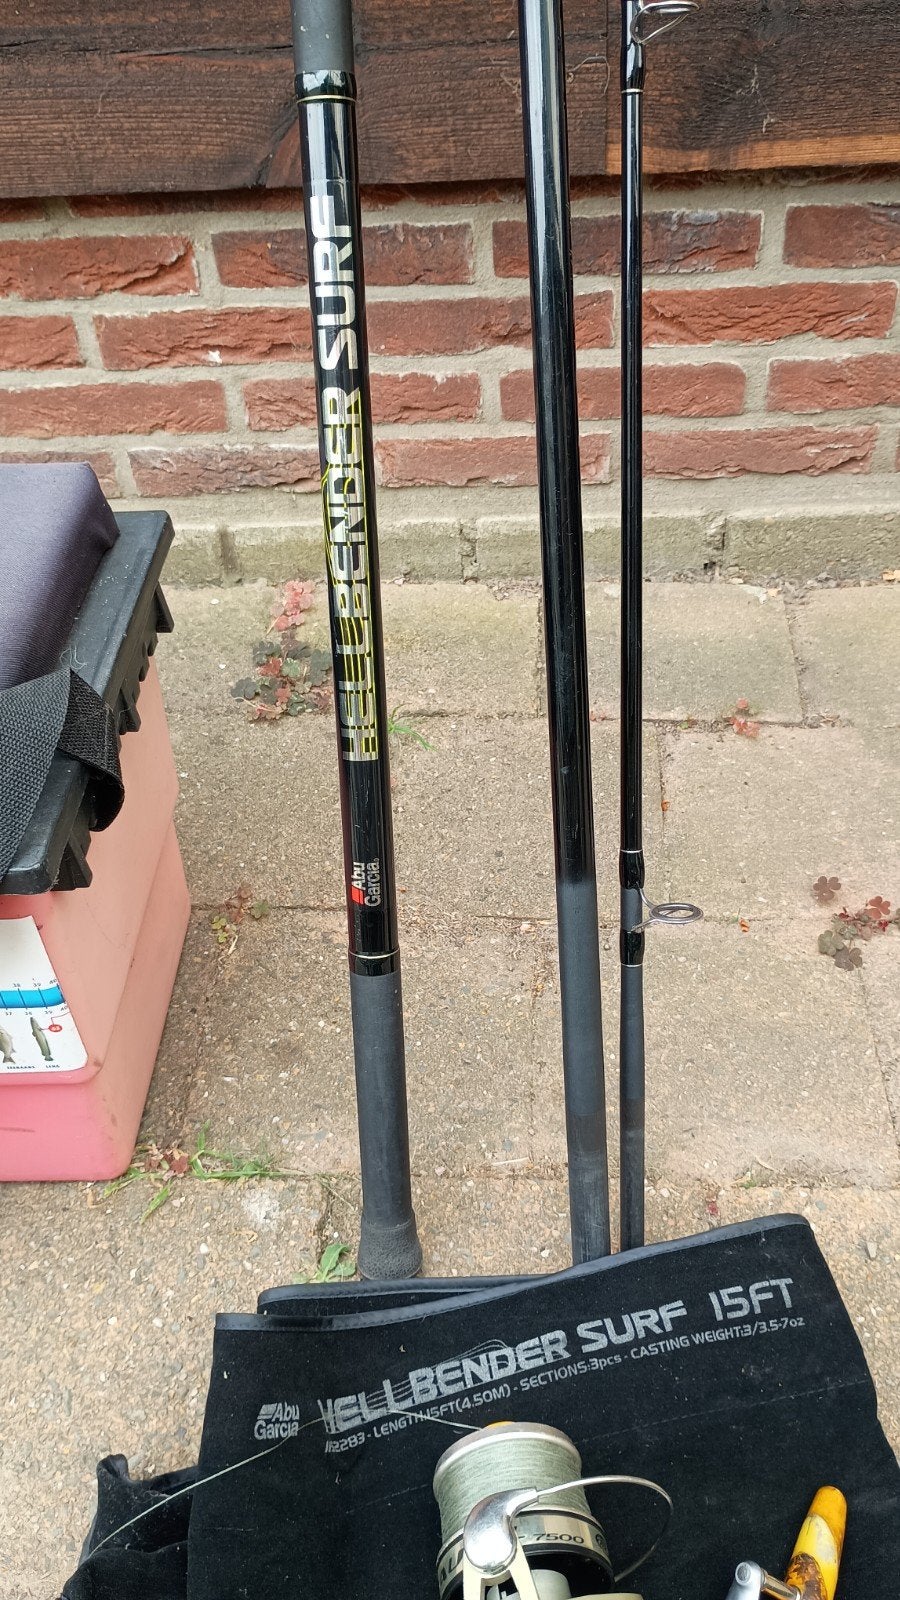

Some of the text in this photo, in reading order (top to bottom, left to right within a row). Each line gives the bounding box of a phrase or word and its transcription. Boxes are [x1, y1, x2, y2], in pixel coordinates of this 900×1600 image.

[310, 195, 379, 761] HELLBENDER SURF
[351, 862, 366, 891] Abu
[364, 861, 381, 907] Garcia
[317, 1277, 794, 1435] HELLBENDER SURF 15FT
[630, 1335, 691, 1360] CASTING
[271, 1402, 300, 1423] Abu
[253, 1421, 300, 1441] Garcia
[533, 1532, 585, 1544] 7500
